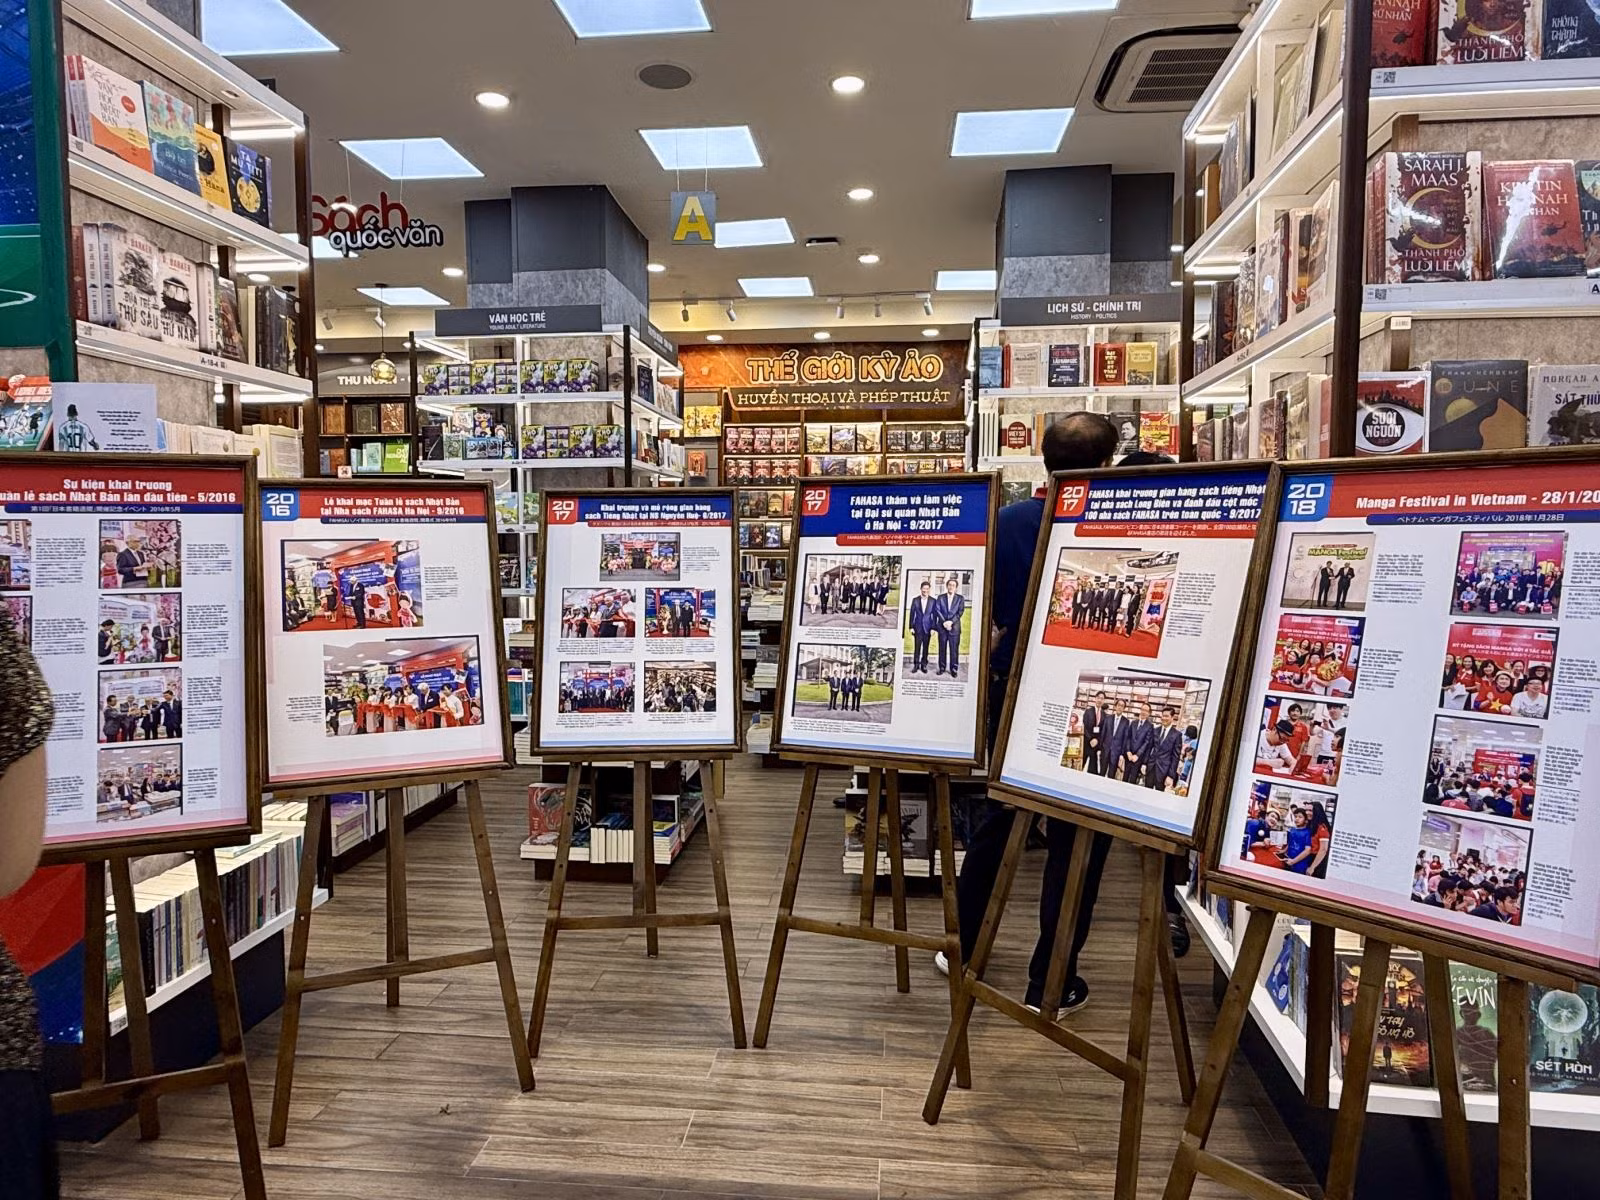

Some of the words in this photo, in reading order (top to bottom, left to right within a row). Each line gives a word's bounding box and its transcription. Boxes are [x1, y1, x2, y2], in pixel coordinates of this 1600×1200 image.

[1405, 159, 1453, 172] SARAH
[1457, 159, 1464, 173] J.
[1411, 173, 1458, 187] MAAS
[672, 195, 713, 242] A
[329, 216, 394, 256] quốc
[395, 219, 441, 245] văn
[1047, 303, 1069, 315] LỊCH
[1092, 299, 1124, 312] CHÍNH
[1125, 300, 1142, 313] TRỊ
[509, 312, 528, 324] HỌC
[529, 309, 546, 322] TRẺ
[746, 350, 798, 384] THẾ
[801, 352, 855, 383] GIỚI
[858, 350, 901, 382] KỲ
[899, 348, 944, 382] ẢO
[337, 375, 361, 385] THU
[1543, 374, 1588, 383] MORGAN
[1438, 380, 1521, 394] DUNE
[737, 388, 789, 405] HUYỀN
[792, 392, 838, 406] THOẠI
[837, 388, 857, 403] VÀ
[859, 388, 899, 403] PHÉP
[897, 388, 950, 405] THUẬT
[108, 479, 132, 490] khai
[1287, 483, 1326, 498] 20
[99, 490, 120, 502] Bản
[197, 491, 236, 503] 5/2016
[266, 493, 295, 504] 20
[804, 489, 826, 501] 20
[1061, 486, 1084, 499] 20
[1088, 488, 1114, 499] FAHASA
[1115, 488, 1132, 499] khai
[1158, 488, 1176, 498] gian
[336, 497, 354, 506] khai
[552, 500, 575, 511] 20
[806, 500, 823, 511] 17
[850, 495, 883, 506] FAHASA
[942, 493, 963, 505] việc
[1063, 499, 1079, 512] 17
[1134, 499, 1152, 509] Long
[1222, 497, 1238, 508] cột
[1239, 495, 1259, 507] mốc
[1355, 496, 1396, 510] Manga
[1399, 494, 1450, 508] Festival
[1453, 494, 1467, 506] in
[1470, 492, 1527, 506] Vietnam
[270, 505, 291, 516] 16
[373, 507, 403, 515] FAHASA
[436, 507, 464, 515] 9/2016
[851, 508, 864, 519] tại
[864, 508, 879, 519] Đại
[918, 507, 940, 518] Nhật
[942, 505, 960, 517] Bản
[1084, 511, 1098, 520] 100
[1131, 509, 1160, 519] FAHASA
[1200, 508, 1222, 520] quốc
[1229, 508, 1262, 519] 9/2017
[1290, 500, 1317, 515] 18
[554, 511, 571, 520] 17
[1504, 513, 1565, 522] 2018年1月28日
[886, 520, 902, 531] Nội
[909, 519, 943, 531] 9/2017
[1535, 1058, 1562, 1071] SÉT
